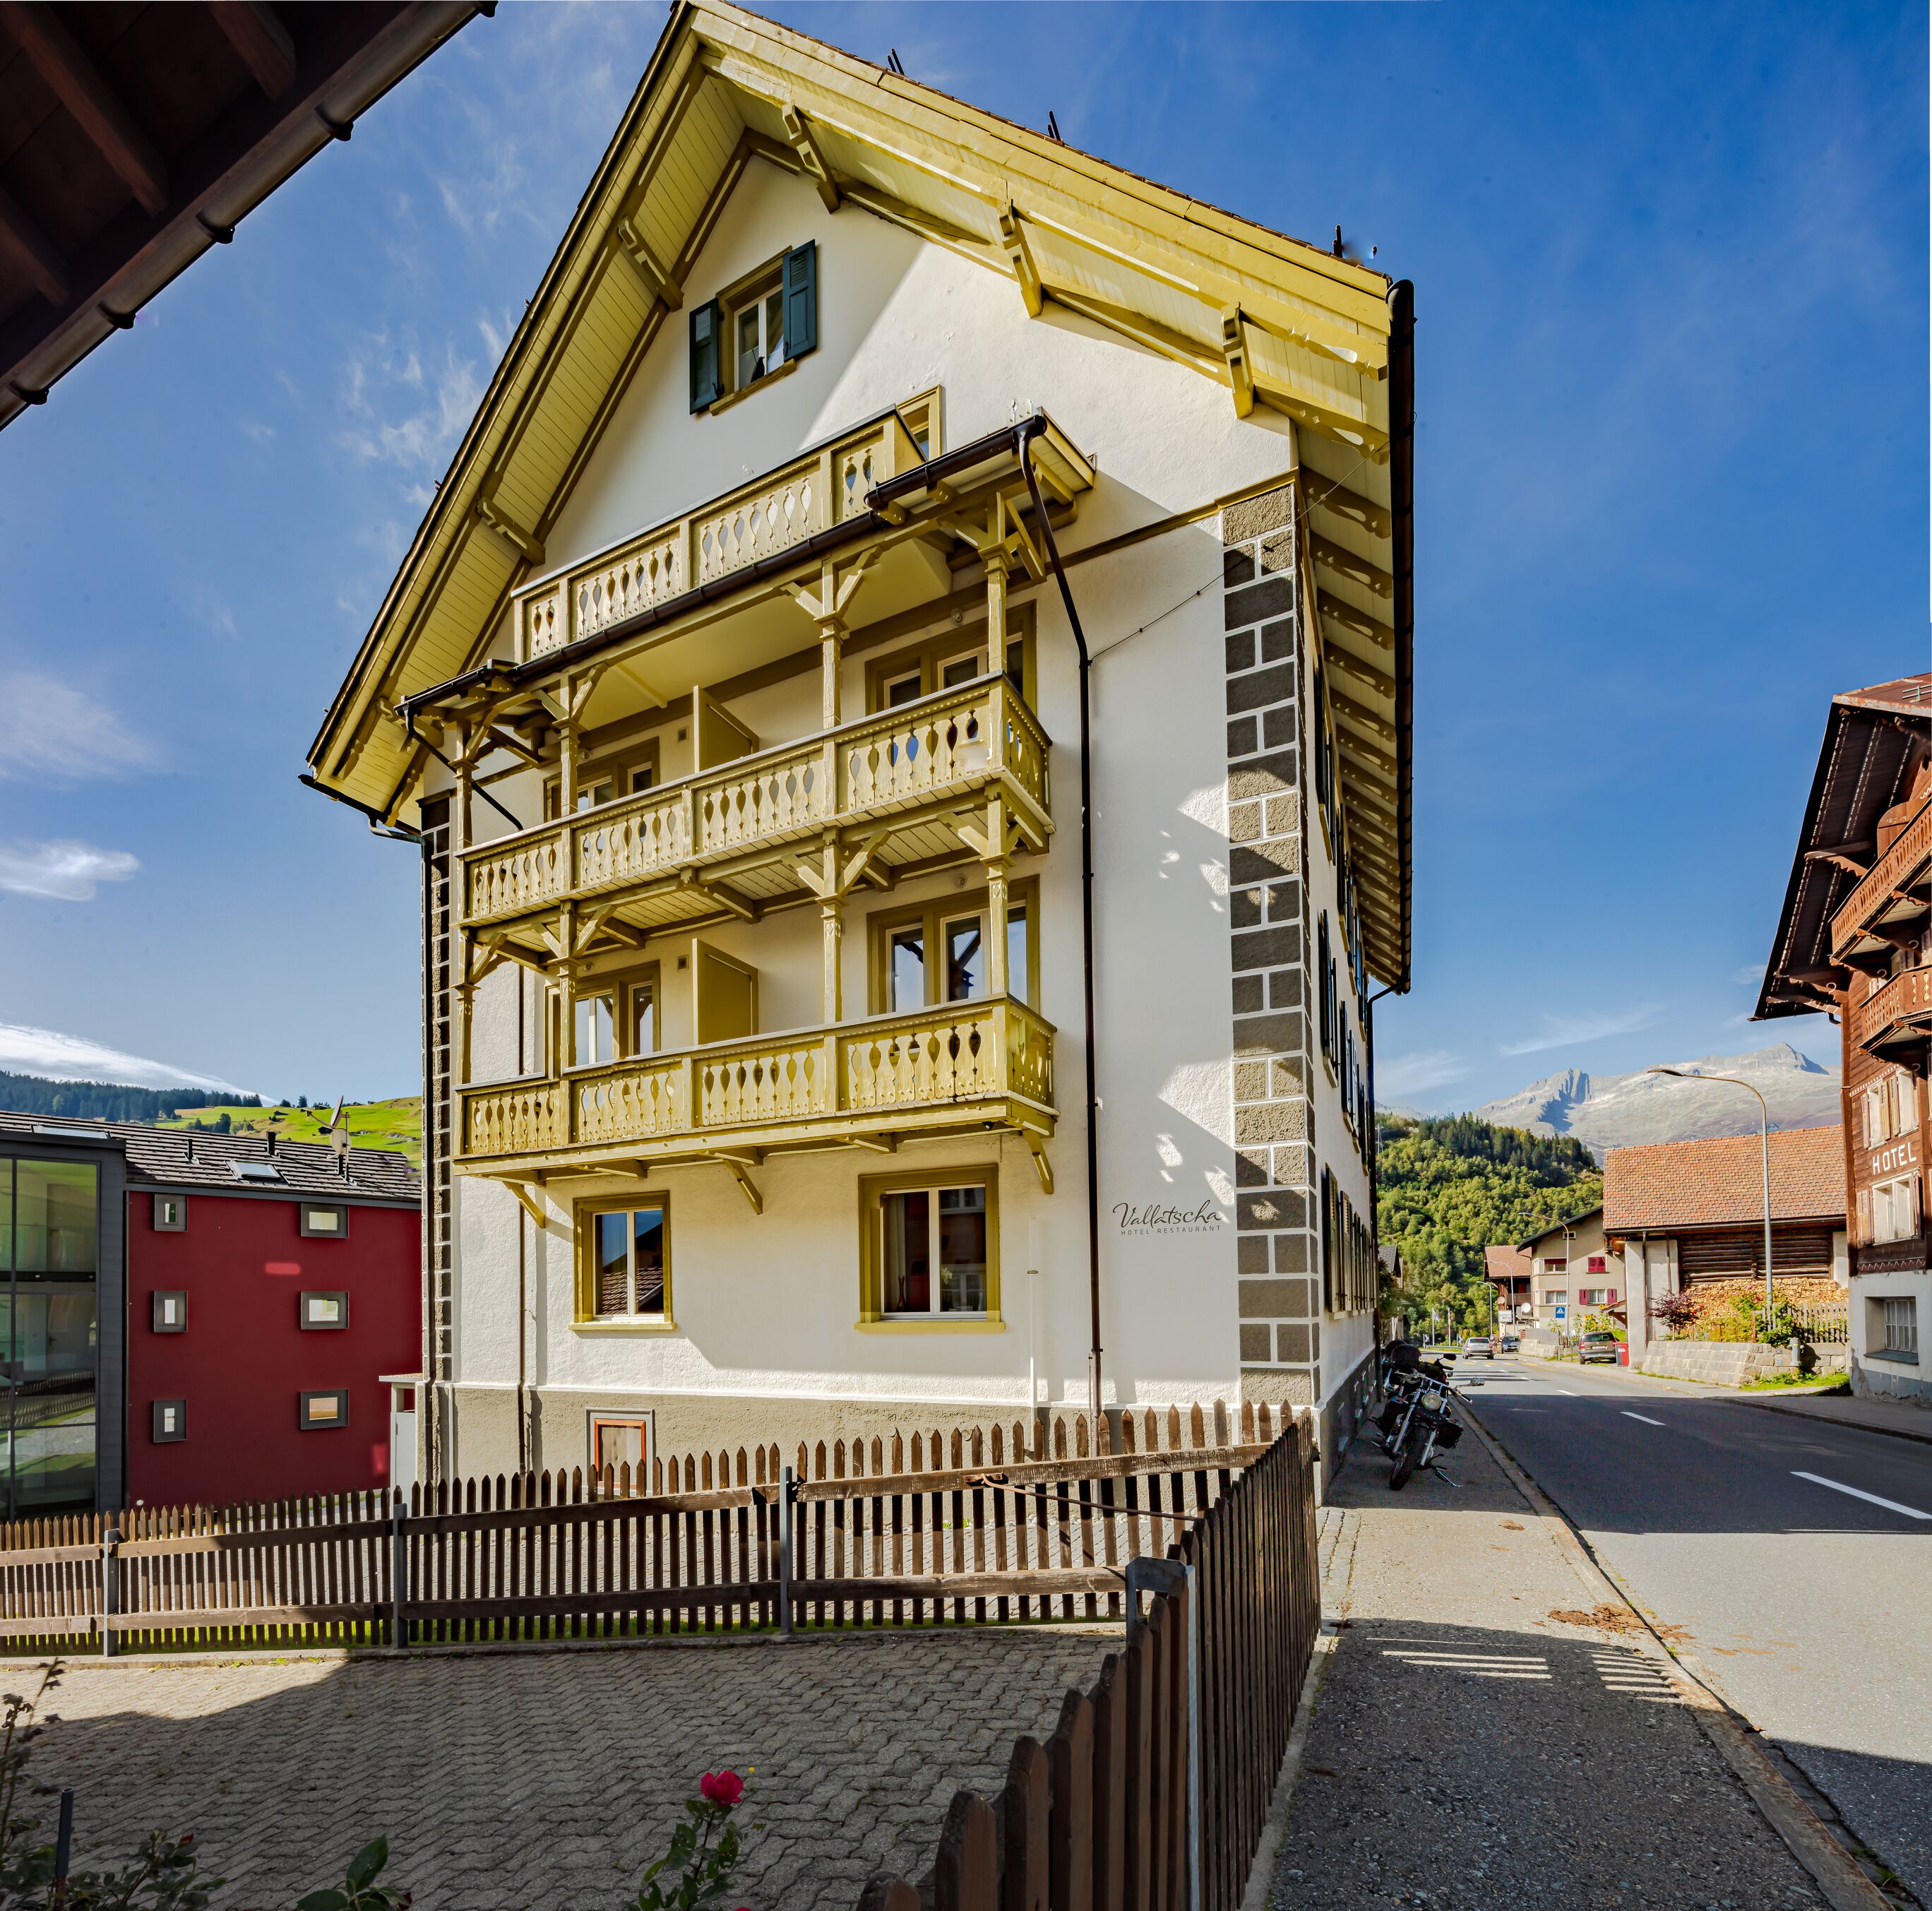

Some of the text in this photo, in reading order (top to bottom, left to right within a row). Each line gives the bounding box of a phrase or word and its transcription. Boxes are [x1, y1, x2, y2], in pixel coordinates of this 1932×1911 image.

[1873, 1142, 1916, 1175] HOTEL
[1112, 1199, 1222, 1228] Vallatscha
[1157, 1225, 1221, 1234] RESTAURANT
